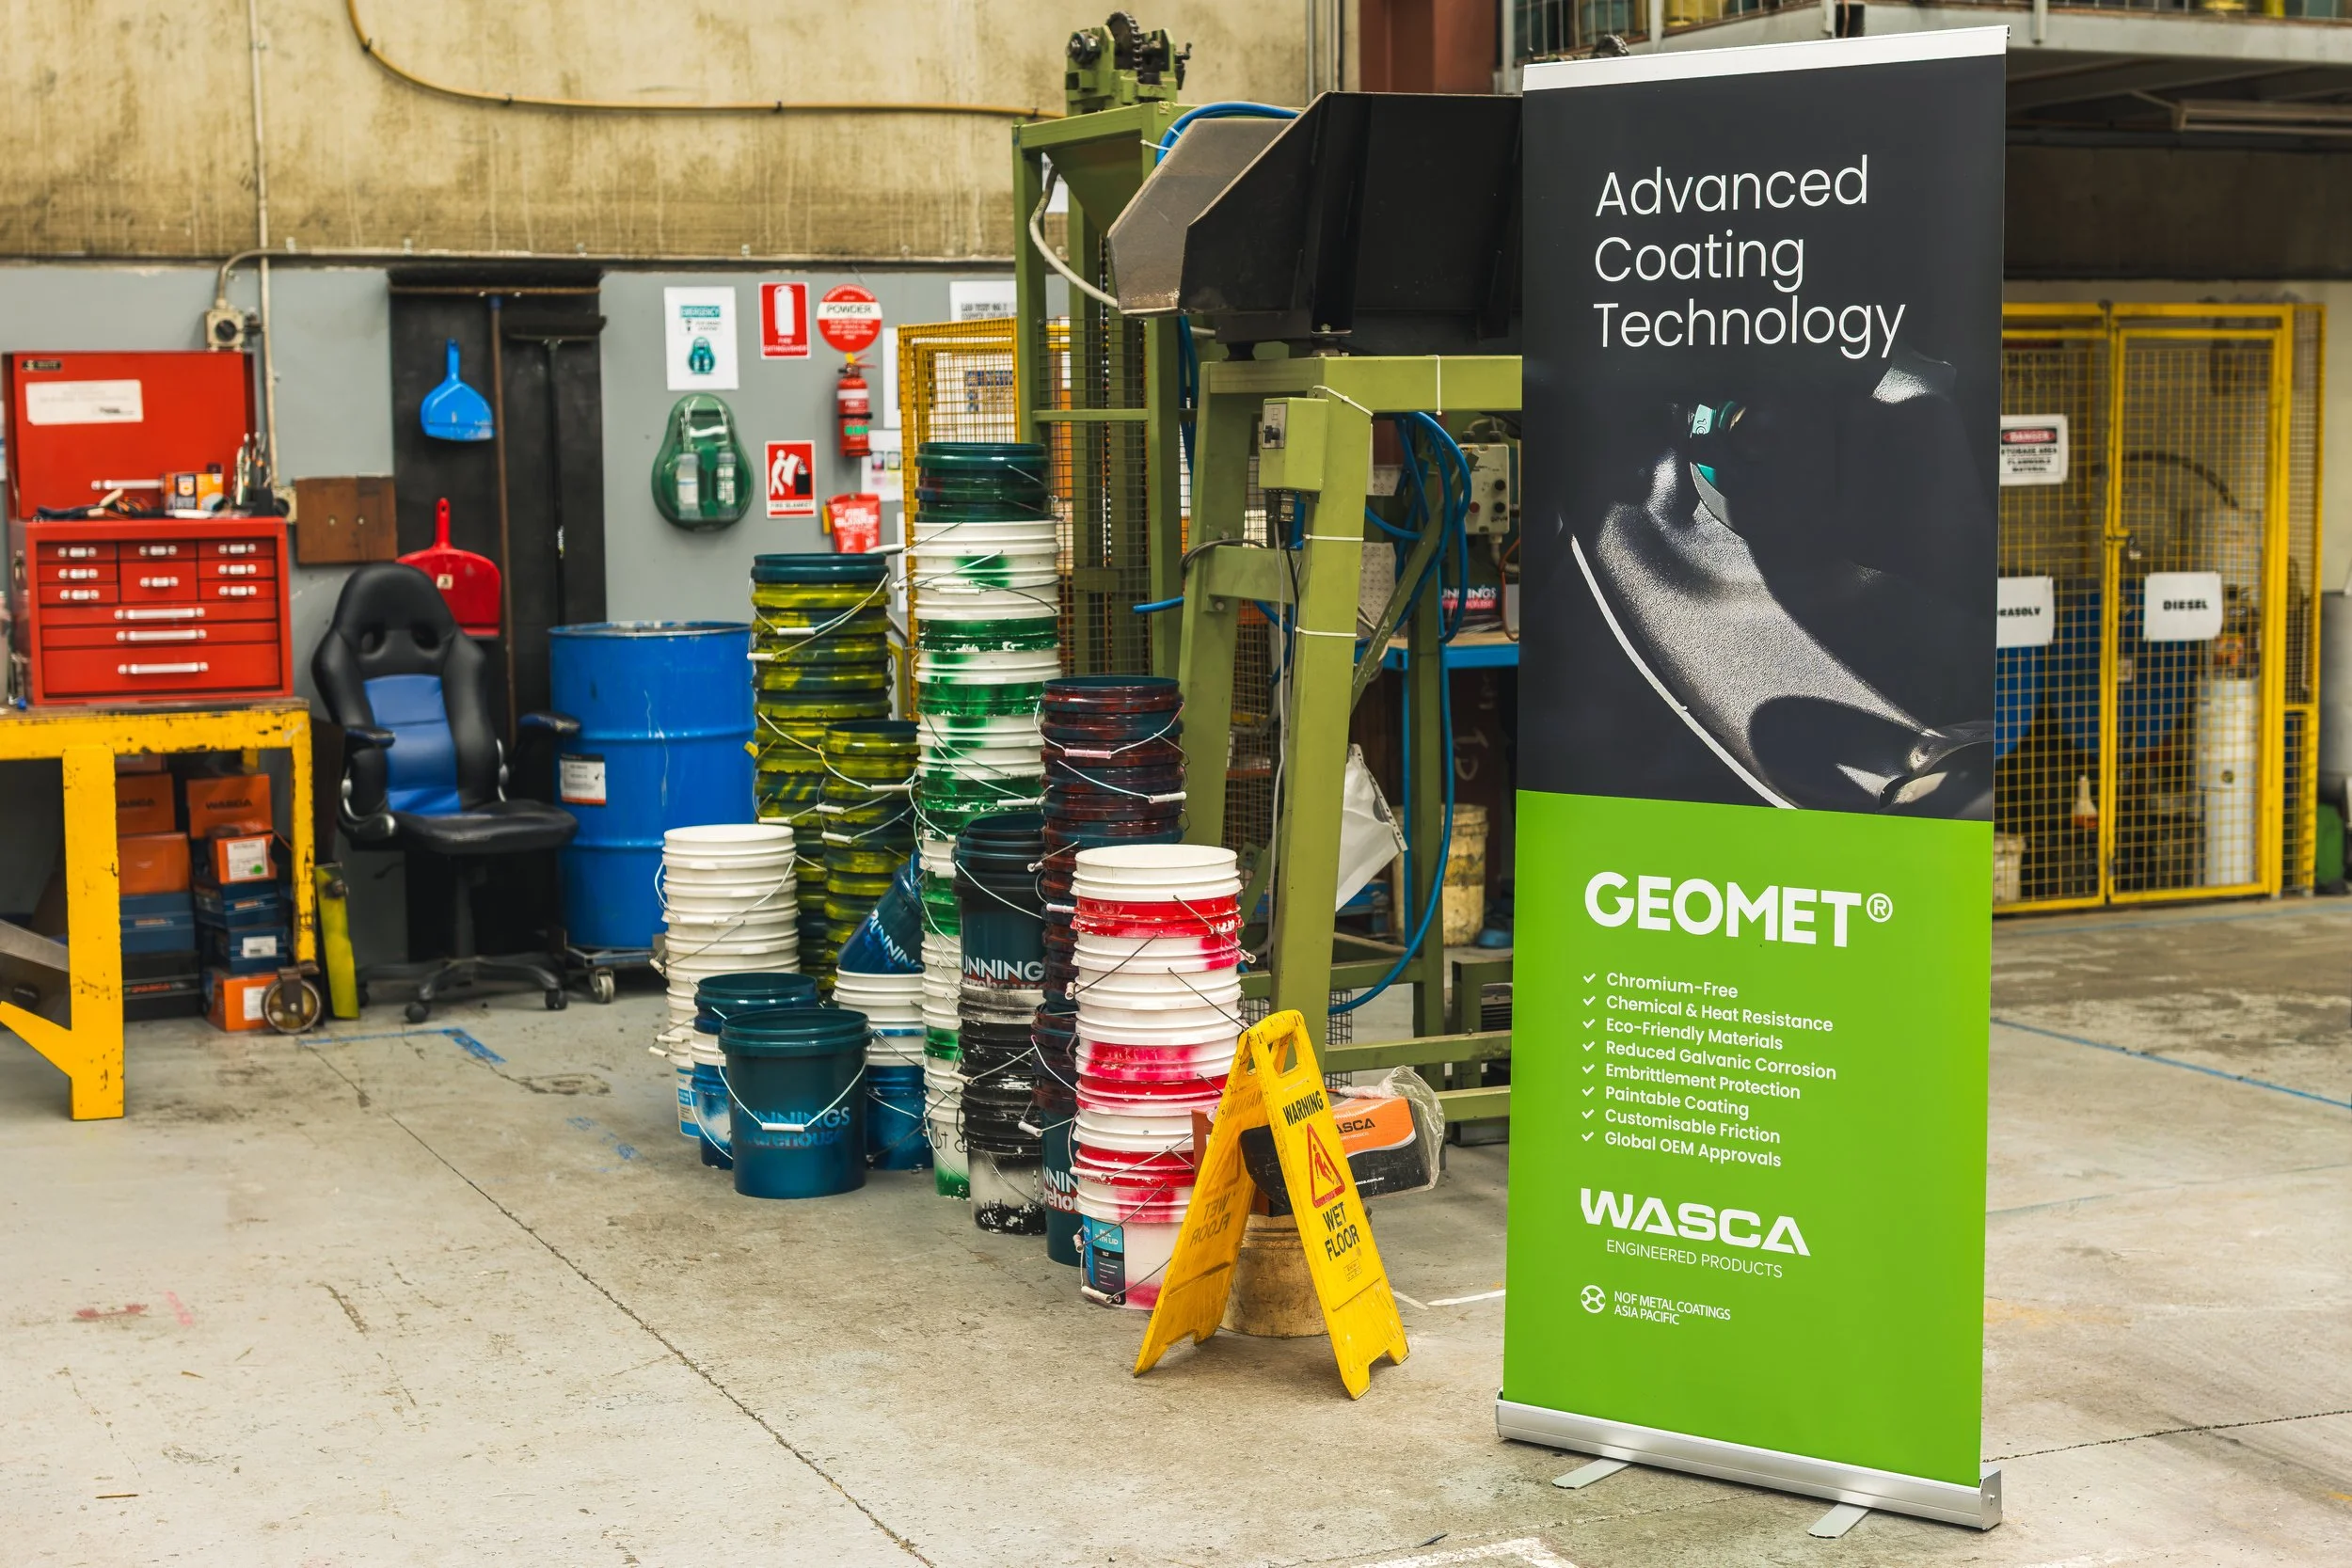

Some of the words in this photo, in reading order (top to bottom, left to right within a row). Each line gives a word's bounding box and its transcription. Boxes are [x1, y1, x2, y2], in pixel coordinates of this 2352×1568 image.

[1595, 153, 1867, 216] Advanced
[1595, 229, 1804, 293] Coating
[827, 304, 872, 314] POWDER
[1593, 294, 1906, 360] Technology
[2163, 599, 2209, 610] DIESEL
[1607, 973, 1739, 999] Chromium-Free
[1607, 995, 1682, 1016] Chemical
[1686, 1004, 1698, 1018] &
[1701, 1006, 1740, 1022] Heat
[1742, 1009, 1834, 1032] Resistance
[1606, 1018, 1705, 1046] Eco-Friendly
[1708, 1029, 1784, 1051] Materials
[1606, 1041, 1676, 1061] Reduced
[1679, 1049, 1752, 1070] Galvanic
[1756, 1057, 1836, 1080] Corrosion
[1606, 1063, 1717, 1089] Embrittlement
[1720, 1077, 1801, 1100] Protection
[1282, 1090, 1325, 1127] WARNING
[1606, 1086, 1681, 1108] Paintable
[1684, 1096, 1749, 1121] Coating
[1605, 1109, 1717, 1135] Customisable
[1720, 1122, 1781, 1144] Friction
[1605, 1132, 1657, 1151] Global
[1660, 1139, 1694, 1156] OEM
[1697, 1144, 1782, 1167] Approvals
[1322, 1201, 1346, 1233] WET
[1581, 1187, 1811, 1257] WASCA
[1325, 1224, 1360, 1261] FLOOR
[1607, 1240, 1697, 1265] ENGINEERED
[1702, 1254, 1783, 1278] PRODUCTS
[1614, 1291, 1638, 1305] NOF
[1640, 1295, 1676, 1312] METAL
[1677, 1301, 1731, 1321] COATINGS
[1614, 1305, 1639, 1319] ASIA
[1640, 1308, 1680, 1325] PACIFIC
